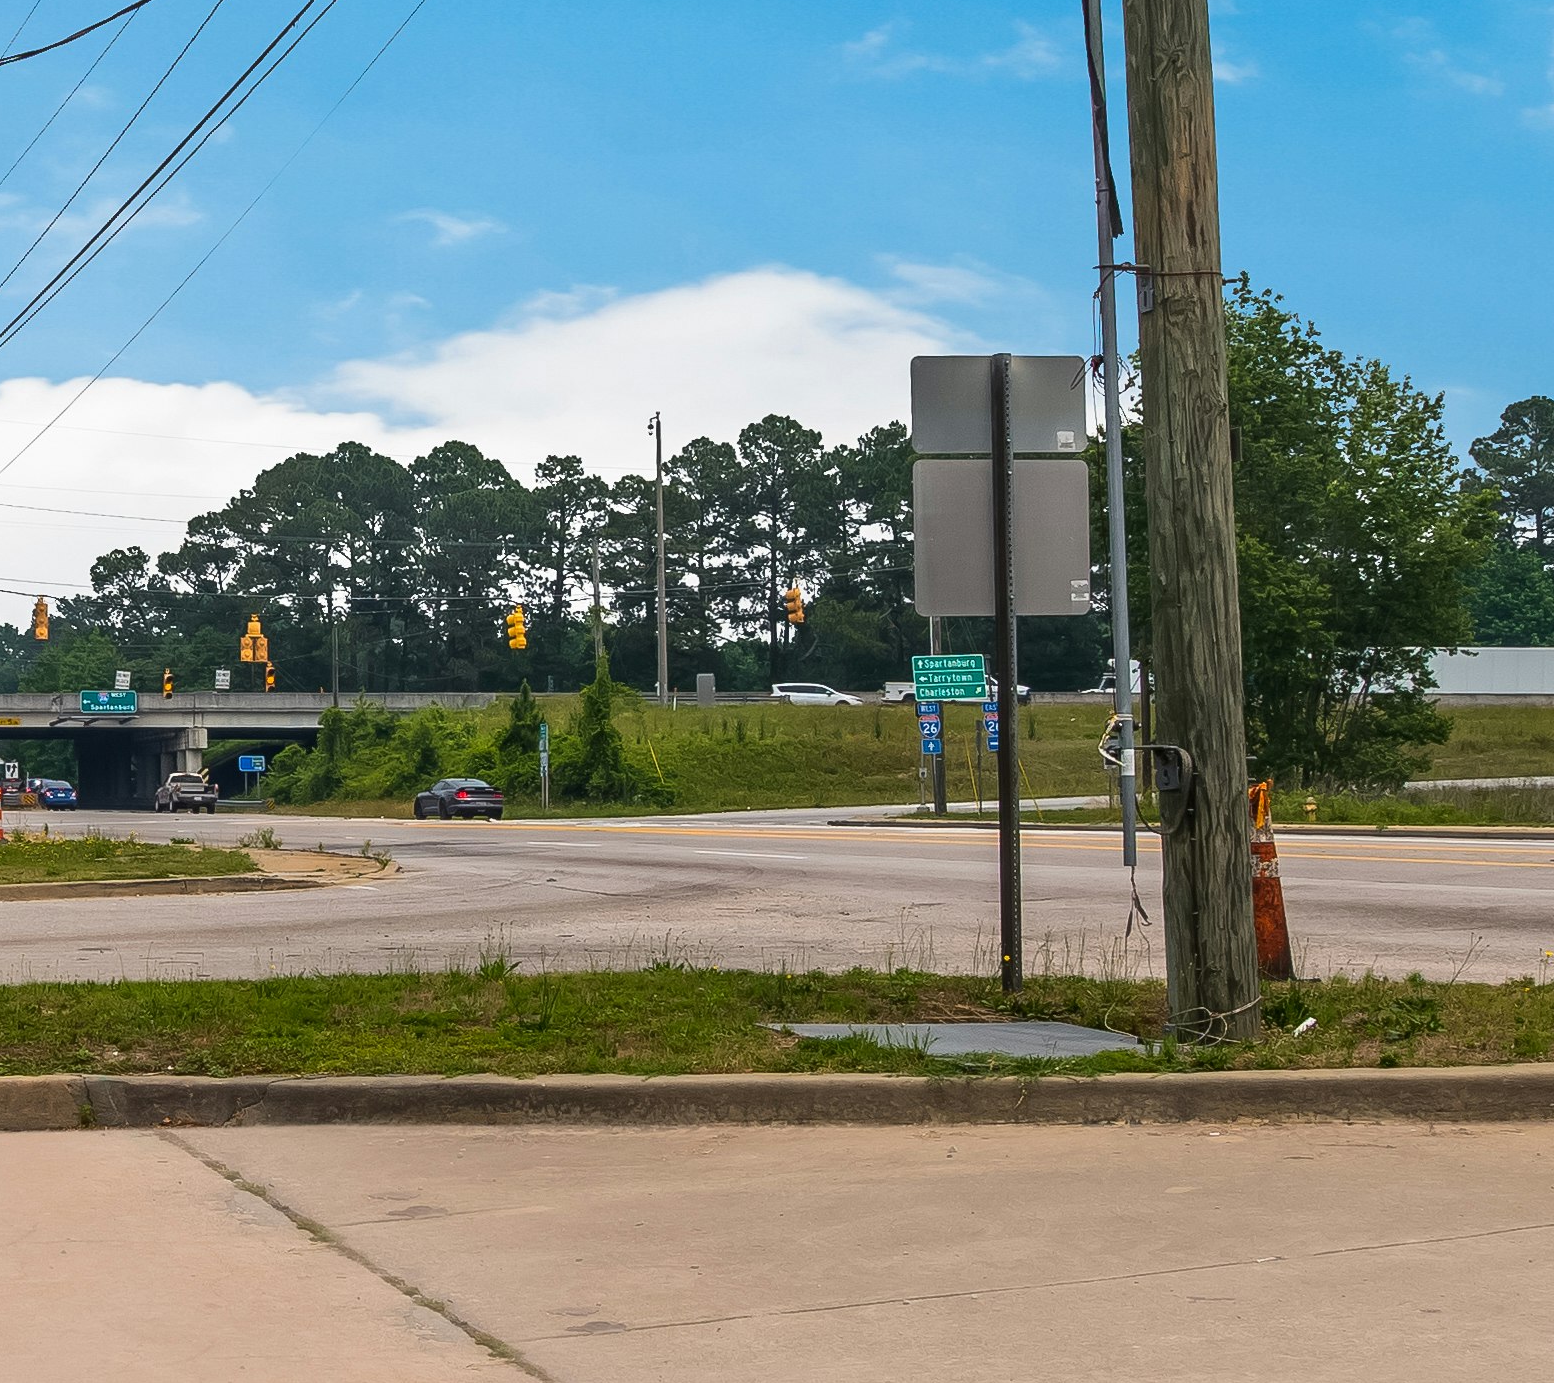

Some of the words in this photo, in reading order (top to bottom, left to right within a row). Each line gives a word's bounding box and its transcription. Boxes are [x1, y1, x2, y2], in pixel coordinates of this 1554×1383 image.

[924, 659, 976, 668] Spartanburg
[928, 673, 973, 683] Tarrytown
[919, 687, 965, 697] Charleston
[90, 703, 135, 711] Spartanburg
[923, 723, 938, 734] 26
